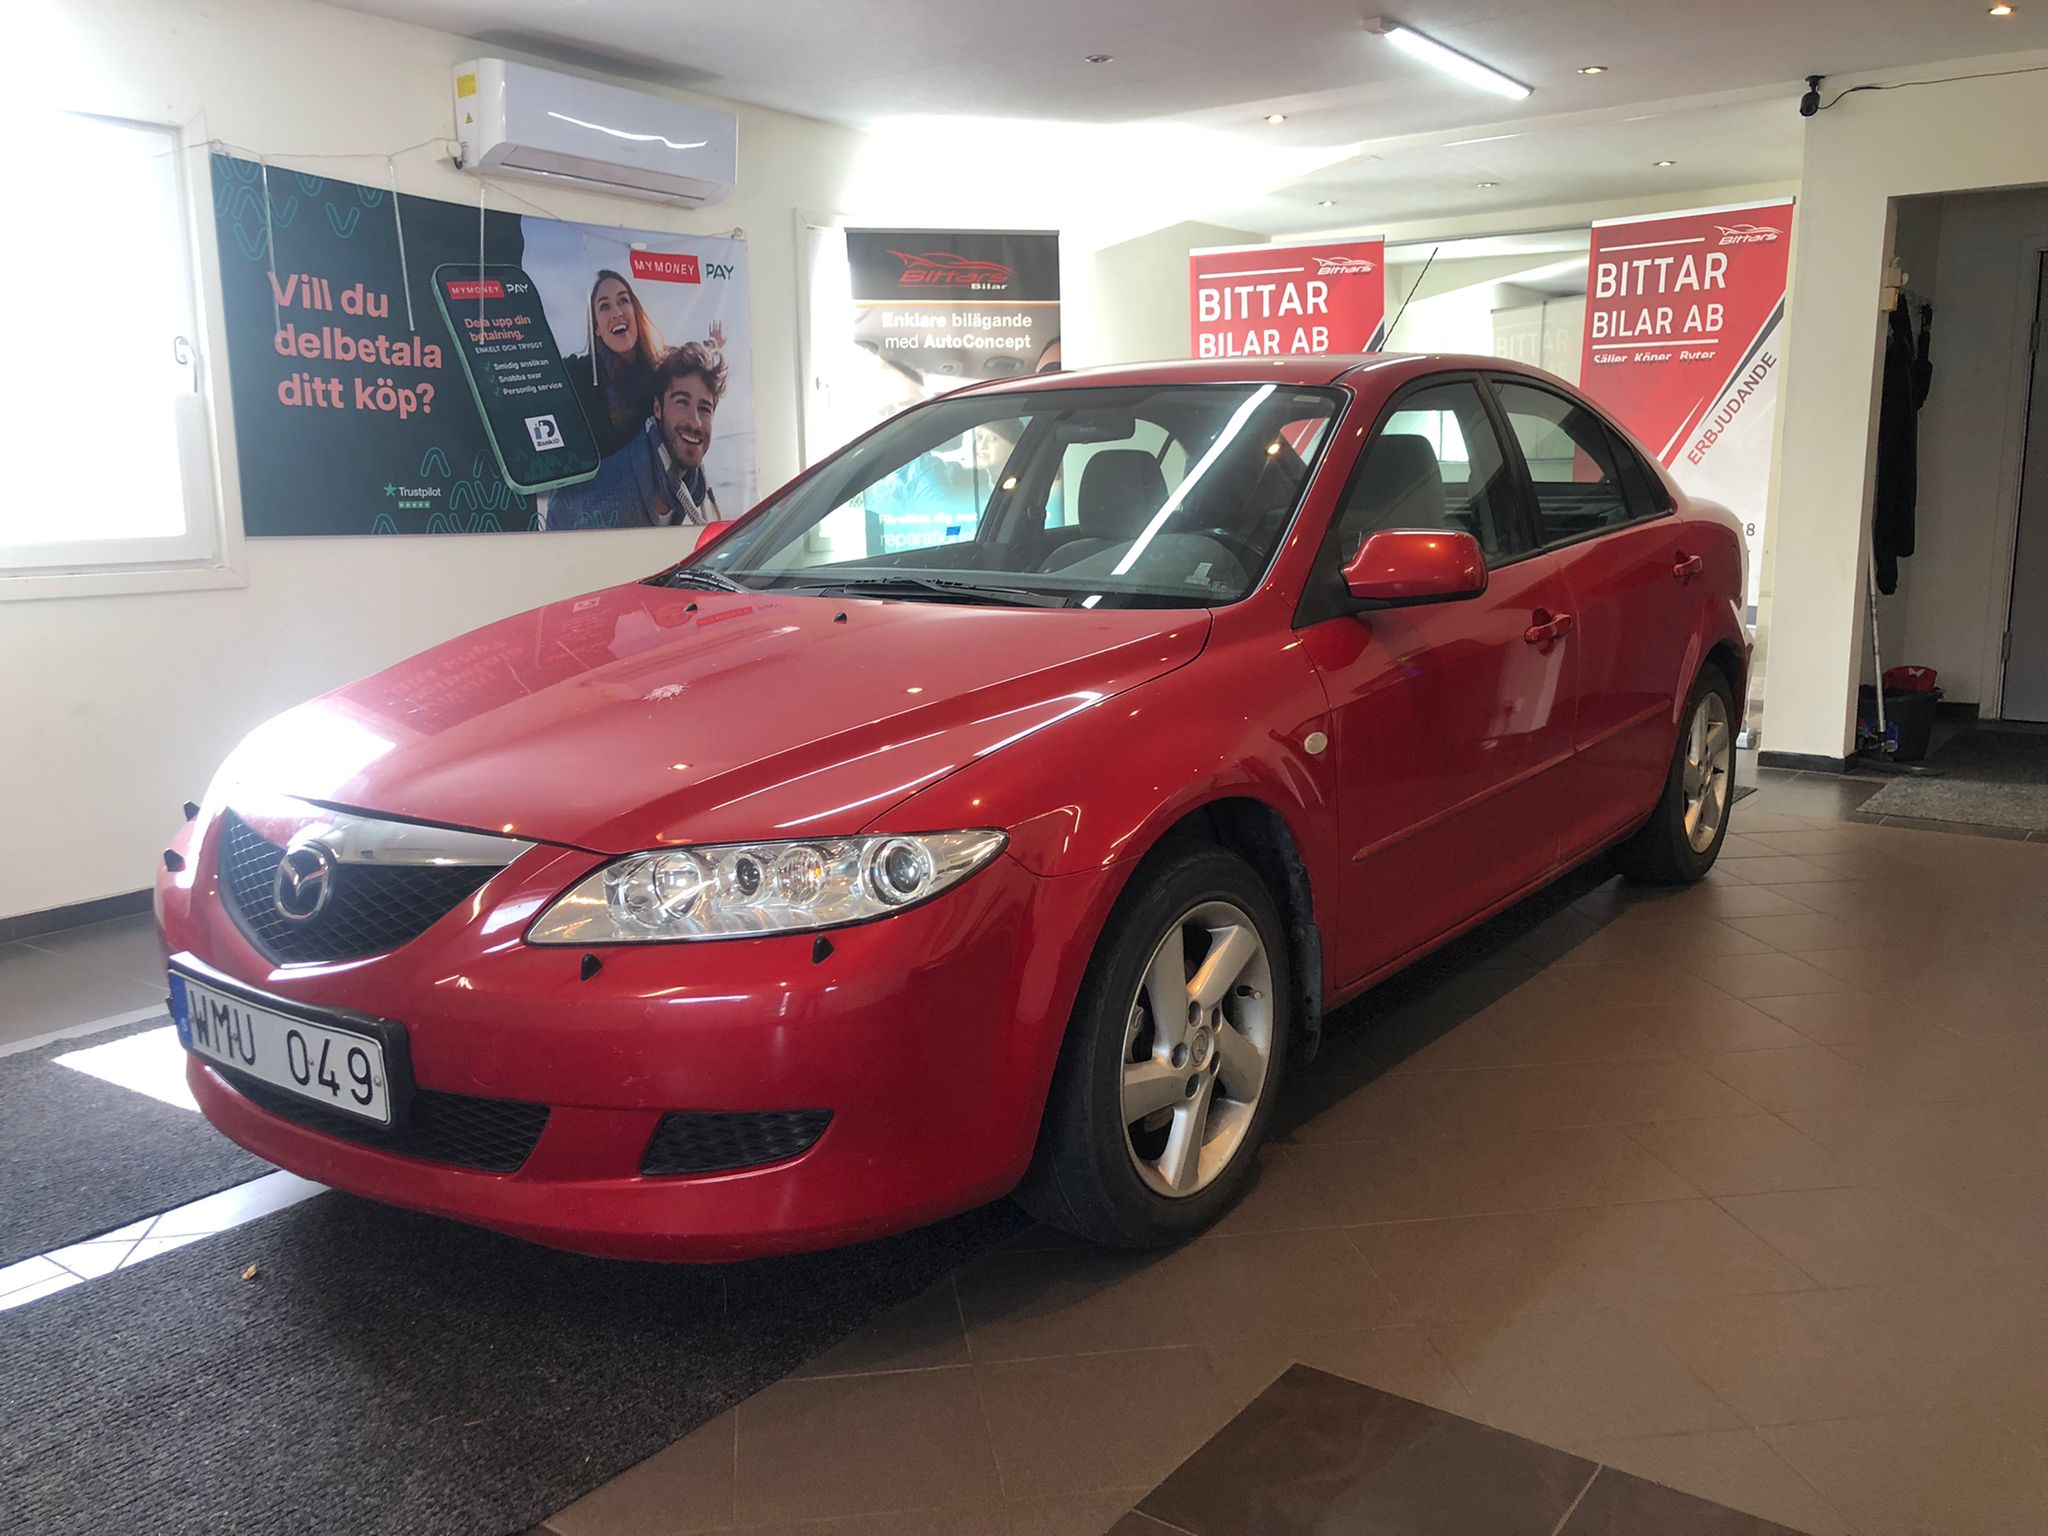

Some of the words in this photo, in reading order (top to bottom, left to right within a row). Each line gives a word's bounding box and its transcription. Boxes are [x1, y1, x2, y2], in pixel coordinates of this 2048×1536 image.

[634, 260, 695, 275] MYMONEY
[706, 263, 734, 280] PAY
[899, 269, 1007, 284] Bittars
[1595, 252, 1728, 299] BITTAR
[267, 271, 333, 312] Vill
[340, 283, 389, 318] du
[451, 285, 499, 295] MYMONEY
[505, 283, 528, 294] PAY
[970, 282, 1008, 291] Bilar
[1198, 281, 1329, 323] BITTAR
[464, 318, 490, 329] Dea
[491, 317, 513, 328] upp
[514, 315, 532, 326] din
[881, 312, 947, 328] Enklare
[952, 312, 1033, 331] bilägande
[1592, 306, 1674, 338] BILAR
[1682, 303, 1725, 333] AB
[274, 323, 442, 369] delbetala
[475, 345, 500, 354] ENKELT
[501, 344, 517, 352] OCH
[518, 341, 543, 350] TRYGGT
[885, 335, 919, 350] med
[924, 334, 1032, 352] AutoConcept
[1199, 329, 1280, 359] BILAR
[1290, 326, 1329, 355] AB
[498, 373, 526, 383] Snabba
[527, 372, 542, 380] svar
[278, 372, 344, 409] ditt
[354, 377, 436, 420] köp?
[503, 385, 537, 396] Personlig
[538, 382, 563, 392] service
[1687, 351, 1777, 465] ERBJUDANDE
[399, 486, 442, 498] Trustpilot
[190, 990, 257, 1067] WMU
[286, 1028, 374, 1106] 049
